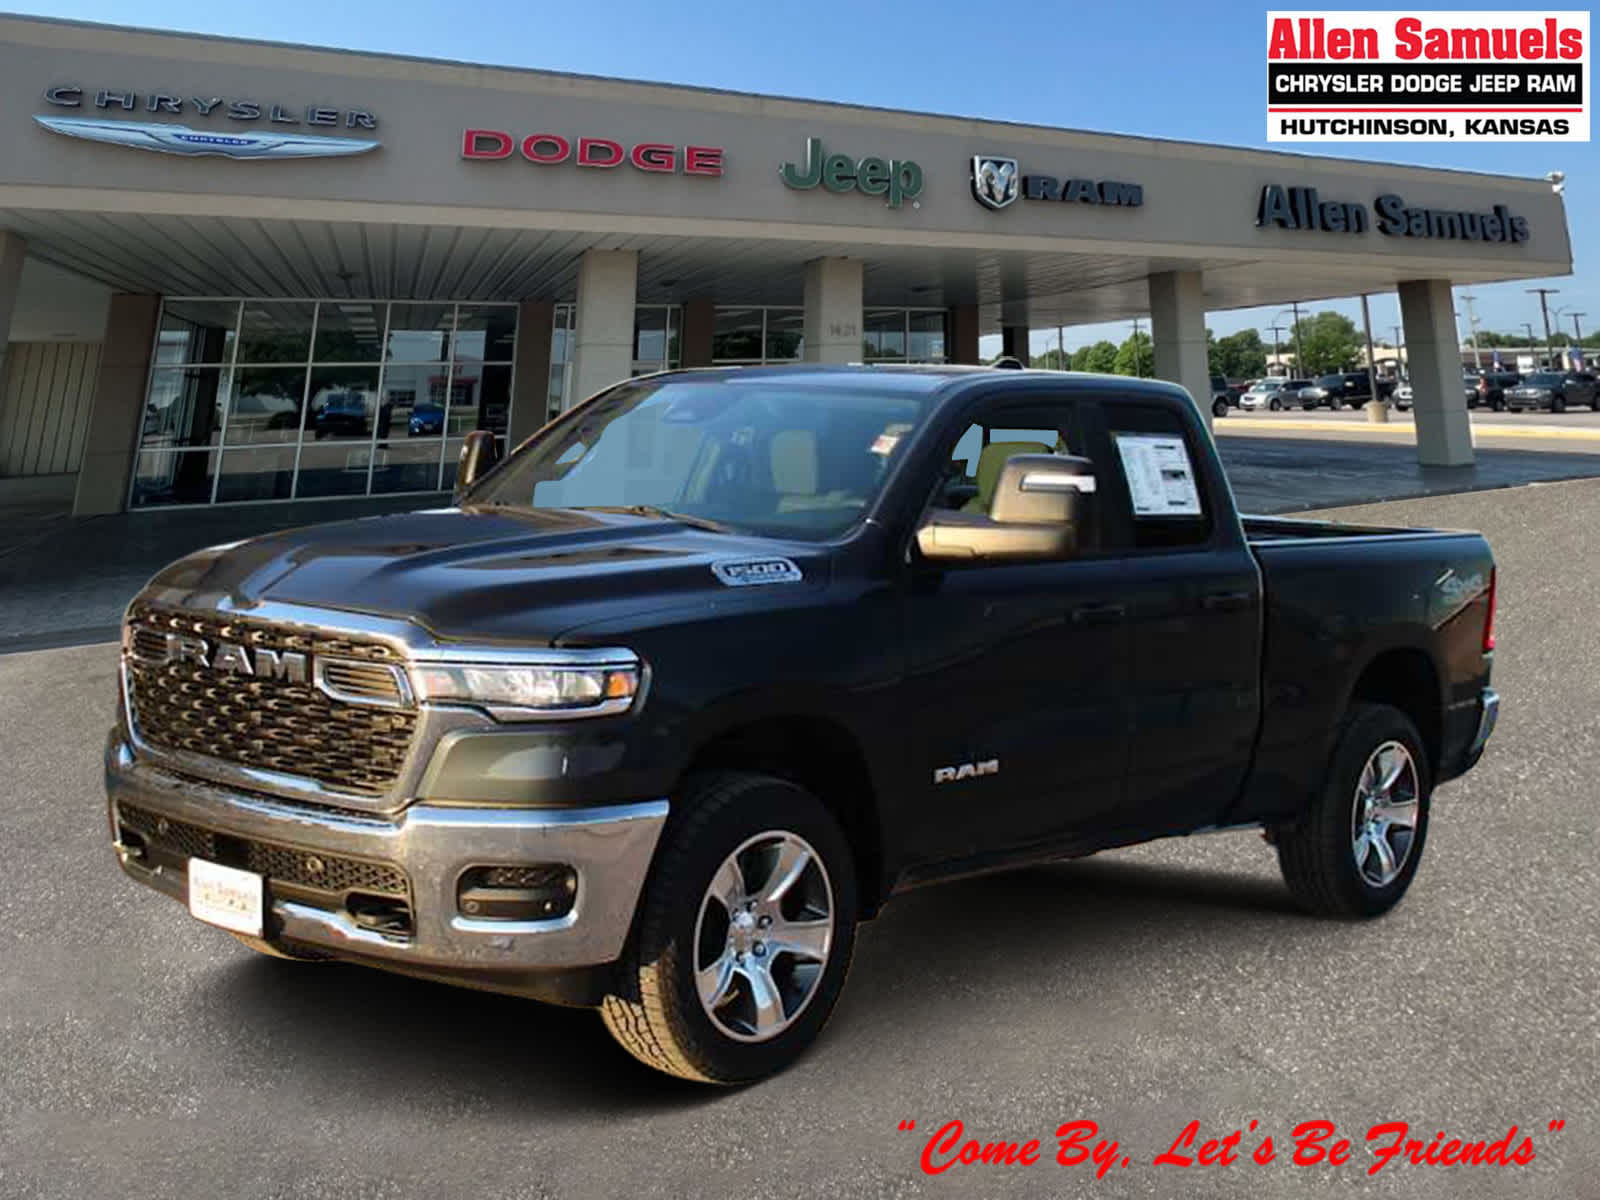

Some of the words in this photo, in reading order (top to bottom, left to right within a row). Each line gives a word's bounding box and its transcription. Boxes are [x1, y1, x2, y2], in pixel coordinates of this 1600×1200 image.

[44, 86, 377, 129] CHRYSLER
[461, 129, 724, 176] DODGE
[780, 136, 923, 209] Jeep
[1022, 175, 1144, 207] RAM
[1255, 184, 1369, 234] Allen
[1374, 194, 1530, 243] Samuels
[163, 633, 307, 685] RAM
[934, 758, 1000, 785] RAM
